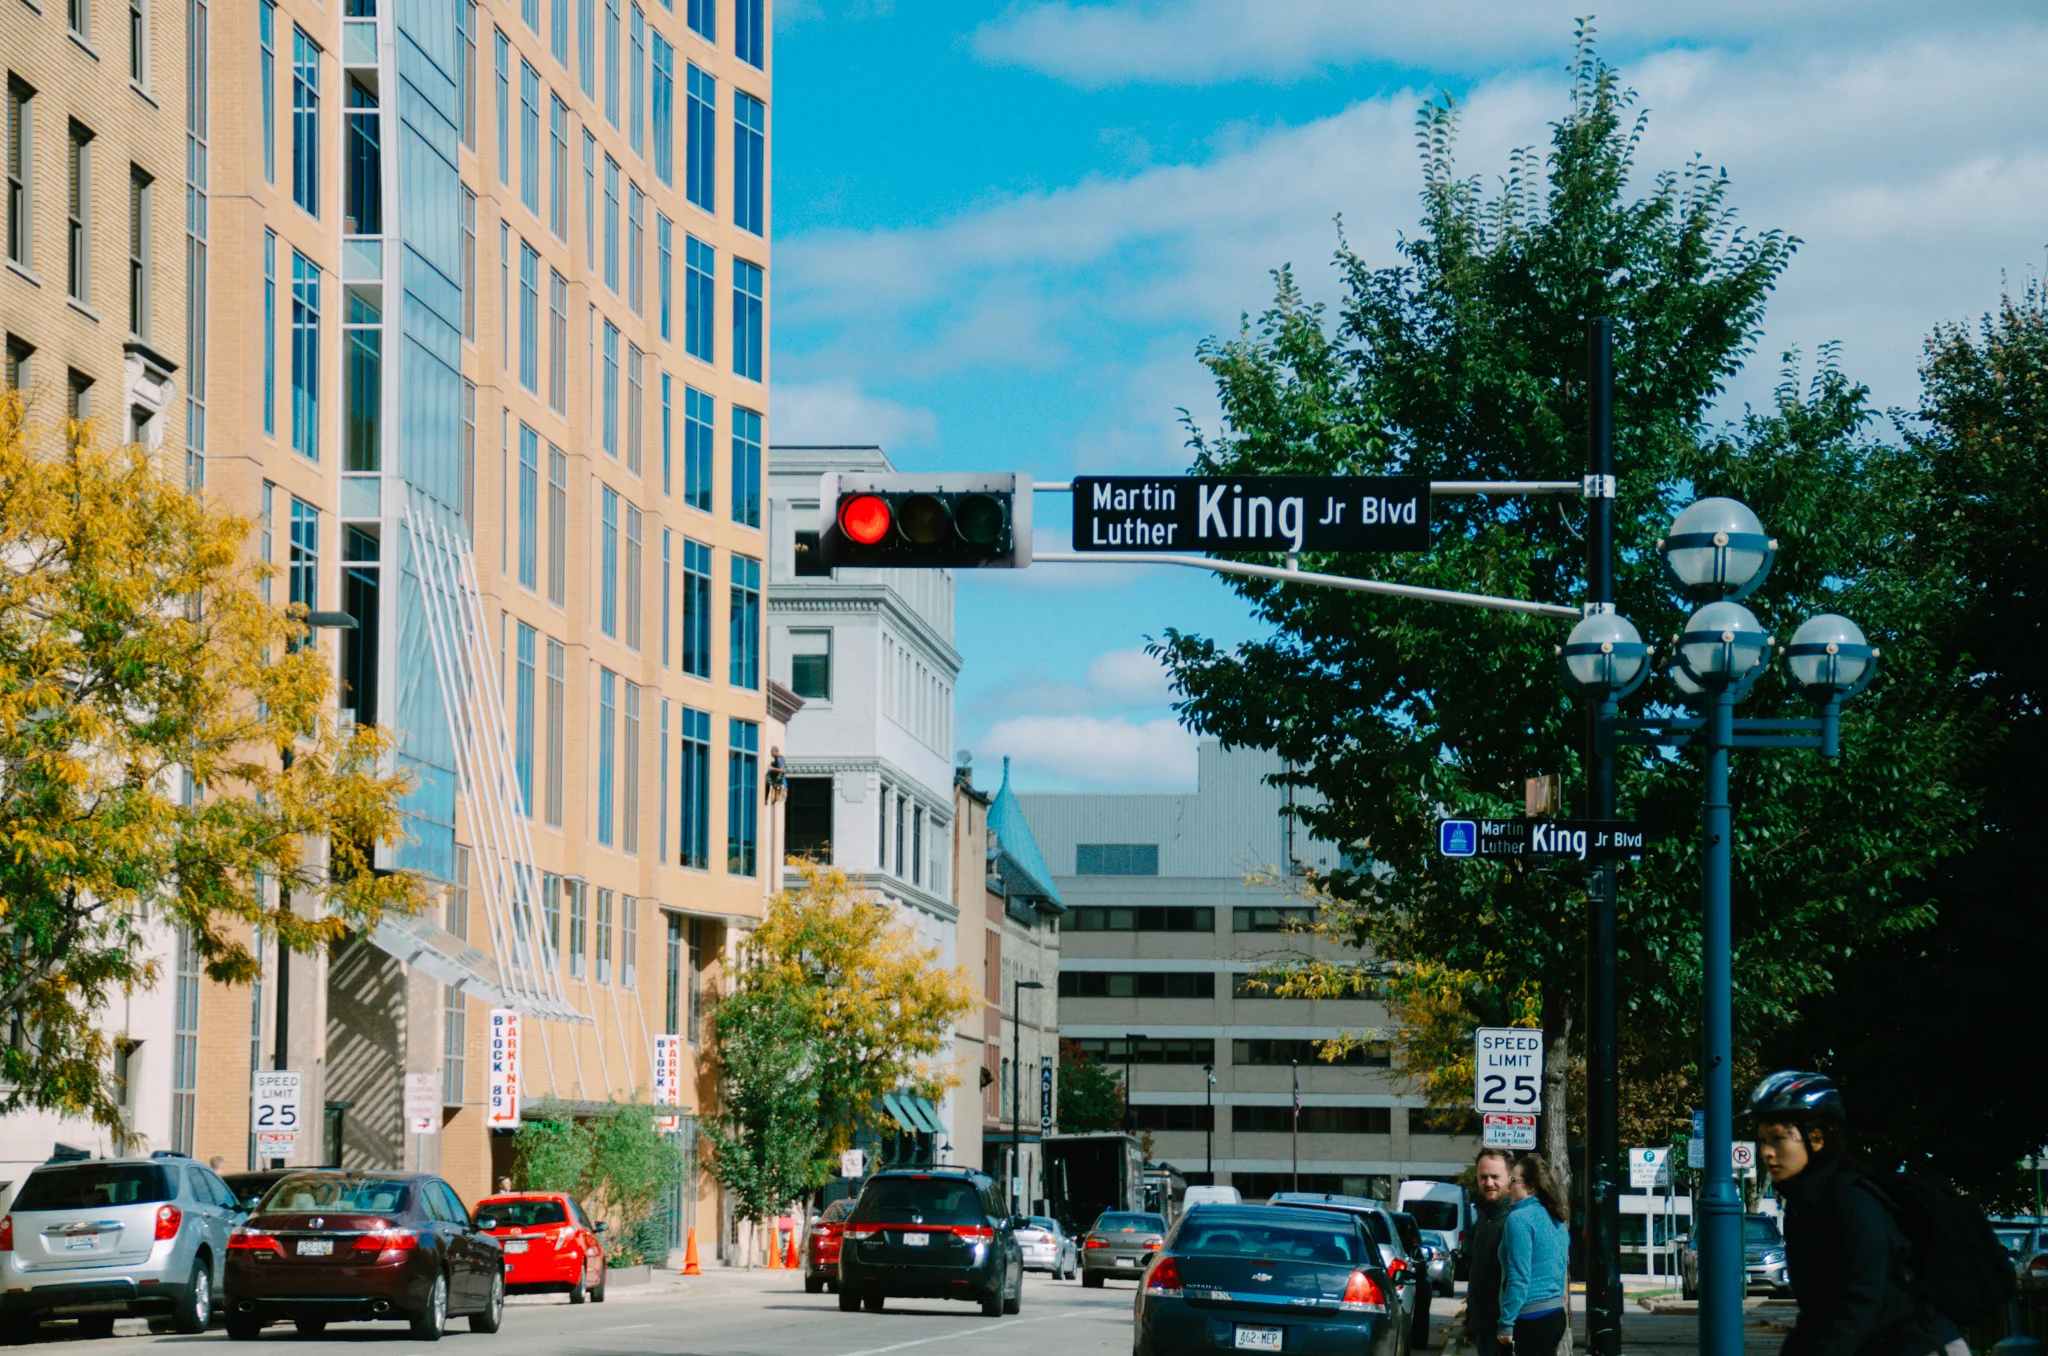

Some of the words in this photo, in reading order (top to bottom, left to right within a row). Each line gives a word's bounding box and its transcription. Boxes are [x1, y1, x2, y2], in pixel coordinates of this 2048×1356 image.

[1093, 483, 1176, 511] Martin
[1092, 517, 1178, 545] Luther
[1198, 484, 1304, 553] King
[1319, 496, 1346, 525] Jr
[1362, 496, 1416, 524] Blvd
[1481, 821, 1524, 836] Martin
[1532, 823, 1587, 861] King
[1595, 832, 1609, 847] Jr
[1614, 832, 1643, 847] Blvd
[1481, 839, 1526, 854] Luther
[493, 1015, 503, 1072] BLOCK
[506, 1015, 517, 1096] PARKING
[1483, 1036, 1539, 1050] SPEED
[656, 1039, 665, 1087] BLOCK
[1489, 1053, 1532, 1067] LIMIT
[258, 1076, 298, 1086] SPEED
[262, 1088, 293, 1099] LIMIT
[1482, 1074, 1537, 1105] 25
[492, 1085, 502, 1107] 89
[1041, 1057, 1052, 1137] MADISON
[258, 1104, 296, 1126] 25
